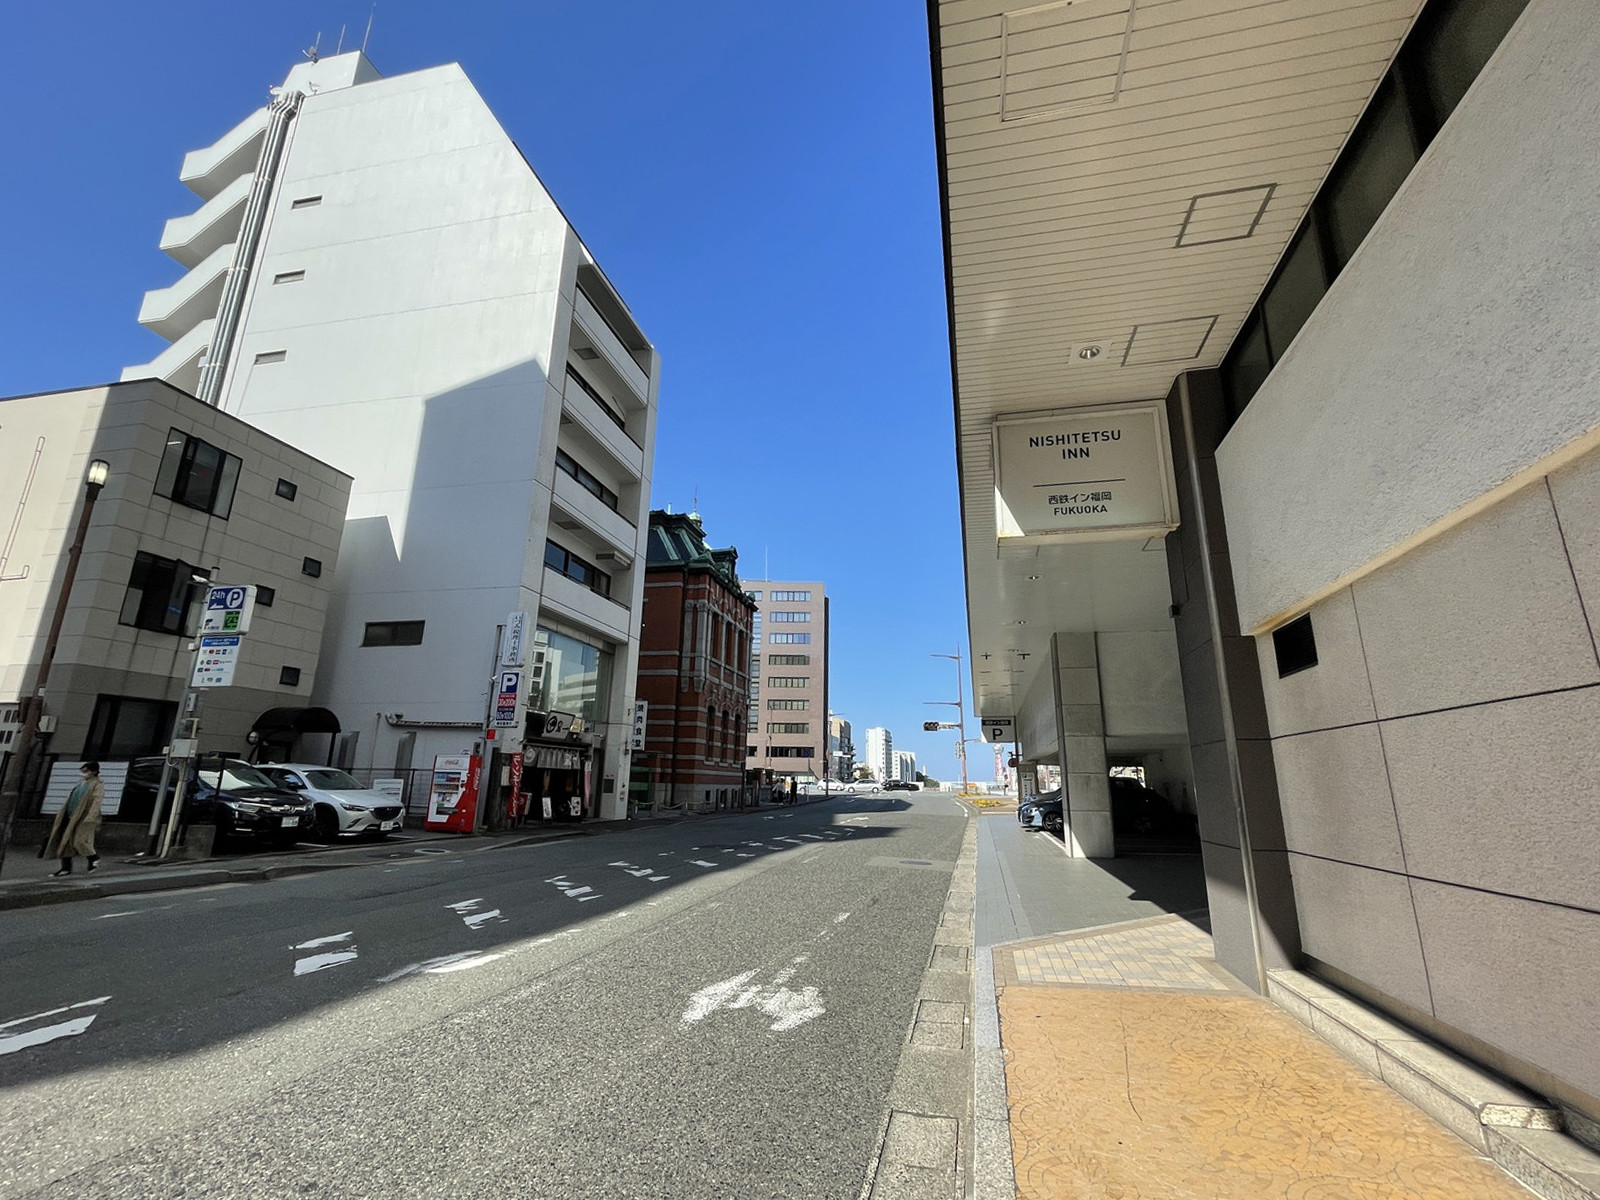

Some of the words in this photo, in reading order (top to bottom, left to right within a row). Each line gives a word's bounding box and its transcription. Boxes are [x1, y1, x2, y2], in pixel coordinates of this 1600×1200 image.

[1029, 430, 1121, 447] NISHITETSU
[1062, 447, 1090, 459] INN
[1048, 492, 1111, 505] 西鉄イン福岡
[1054, 504, 1108, 515] FUKUOKA
[228, 590, 242, 607] P
[501, 674, 517, 692] P
[992, 728, 1003, 740] P
